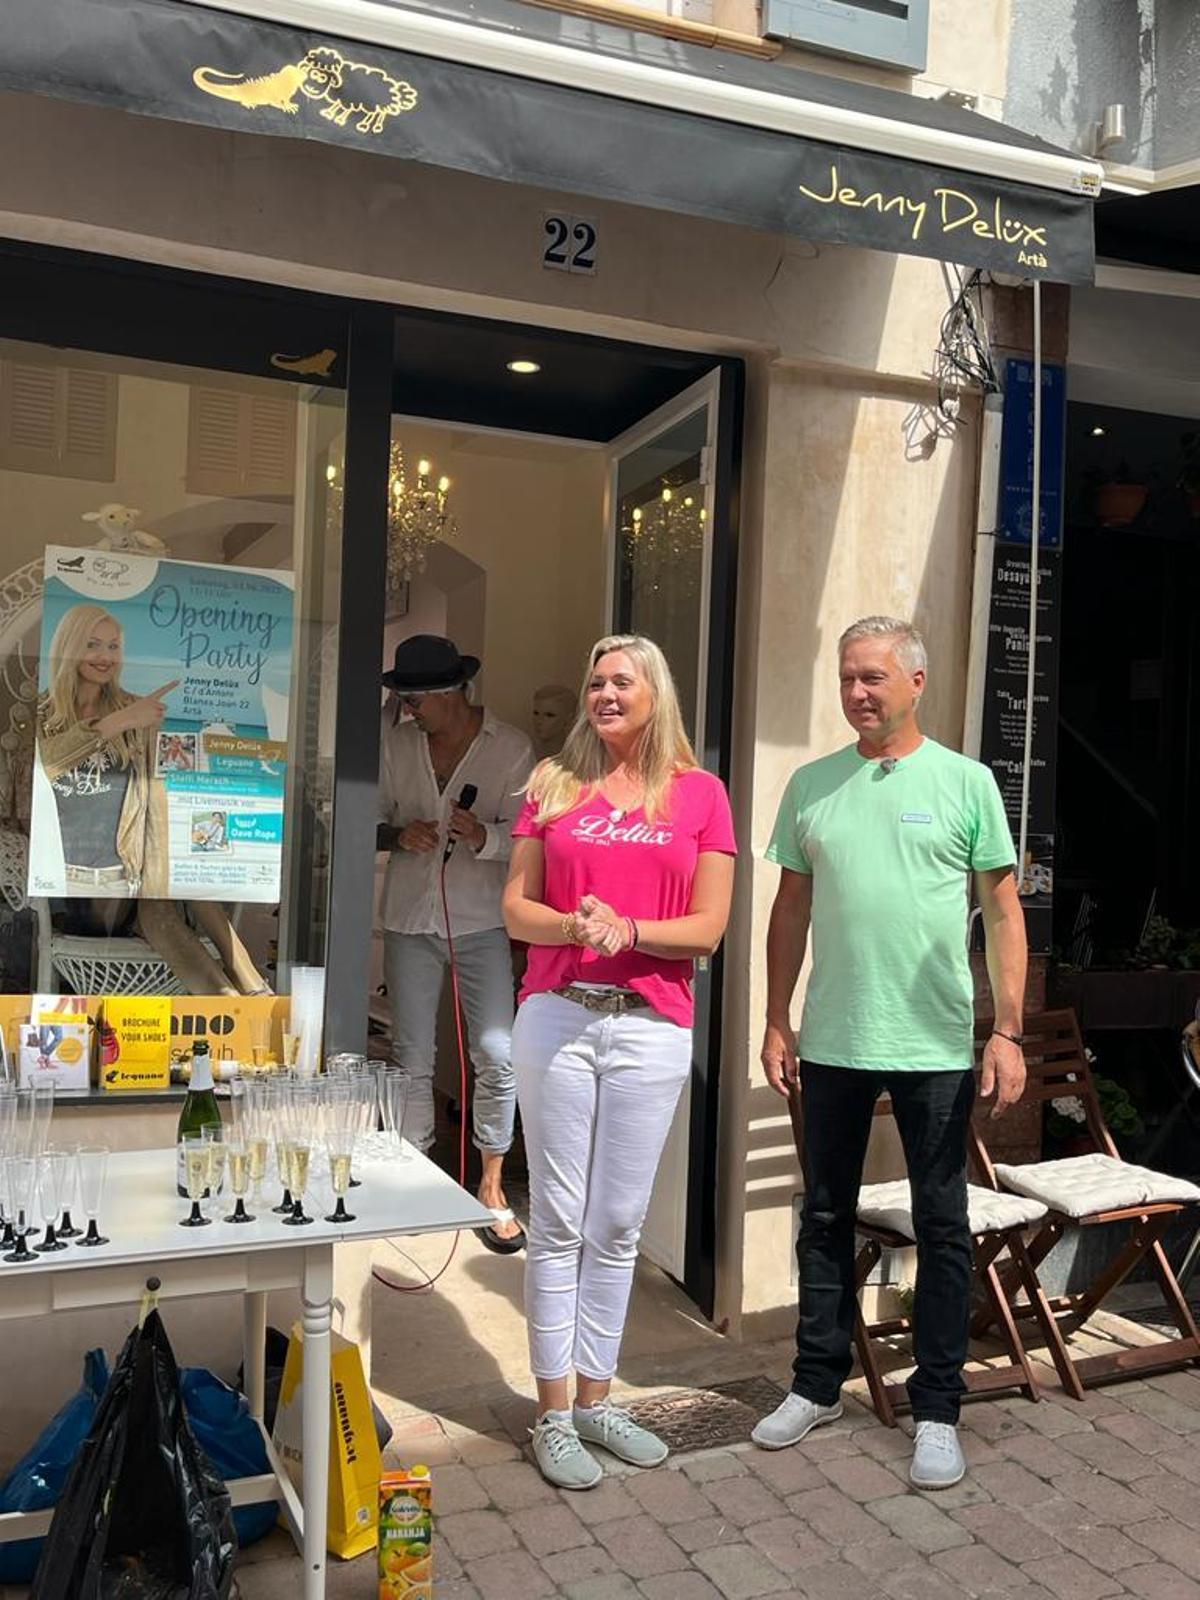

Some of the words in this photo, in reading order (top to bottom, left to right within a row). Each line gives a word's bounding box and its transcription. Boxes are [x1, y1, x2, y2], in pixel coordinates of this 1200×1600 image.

[800, 166, 926, 240] Jenny
[934, 188, 1047, 246] Delüx
[545, 218, 596, 268] 22
[1017, 250, 1048, 268] Artà
[997, 568, 1041, 585] Desayuo
[149, 584, 280, 650] Opening
[178, 630, 268, 685] Party
[184, 677, 210, 687] Jenny
[122, 1017, 160, 1027] BROCHURE
[121, 1032, 142, 1042] YOUR
[143, 1032, 167, 1042] SHOES
